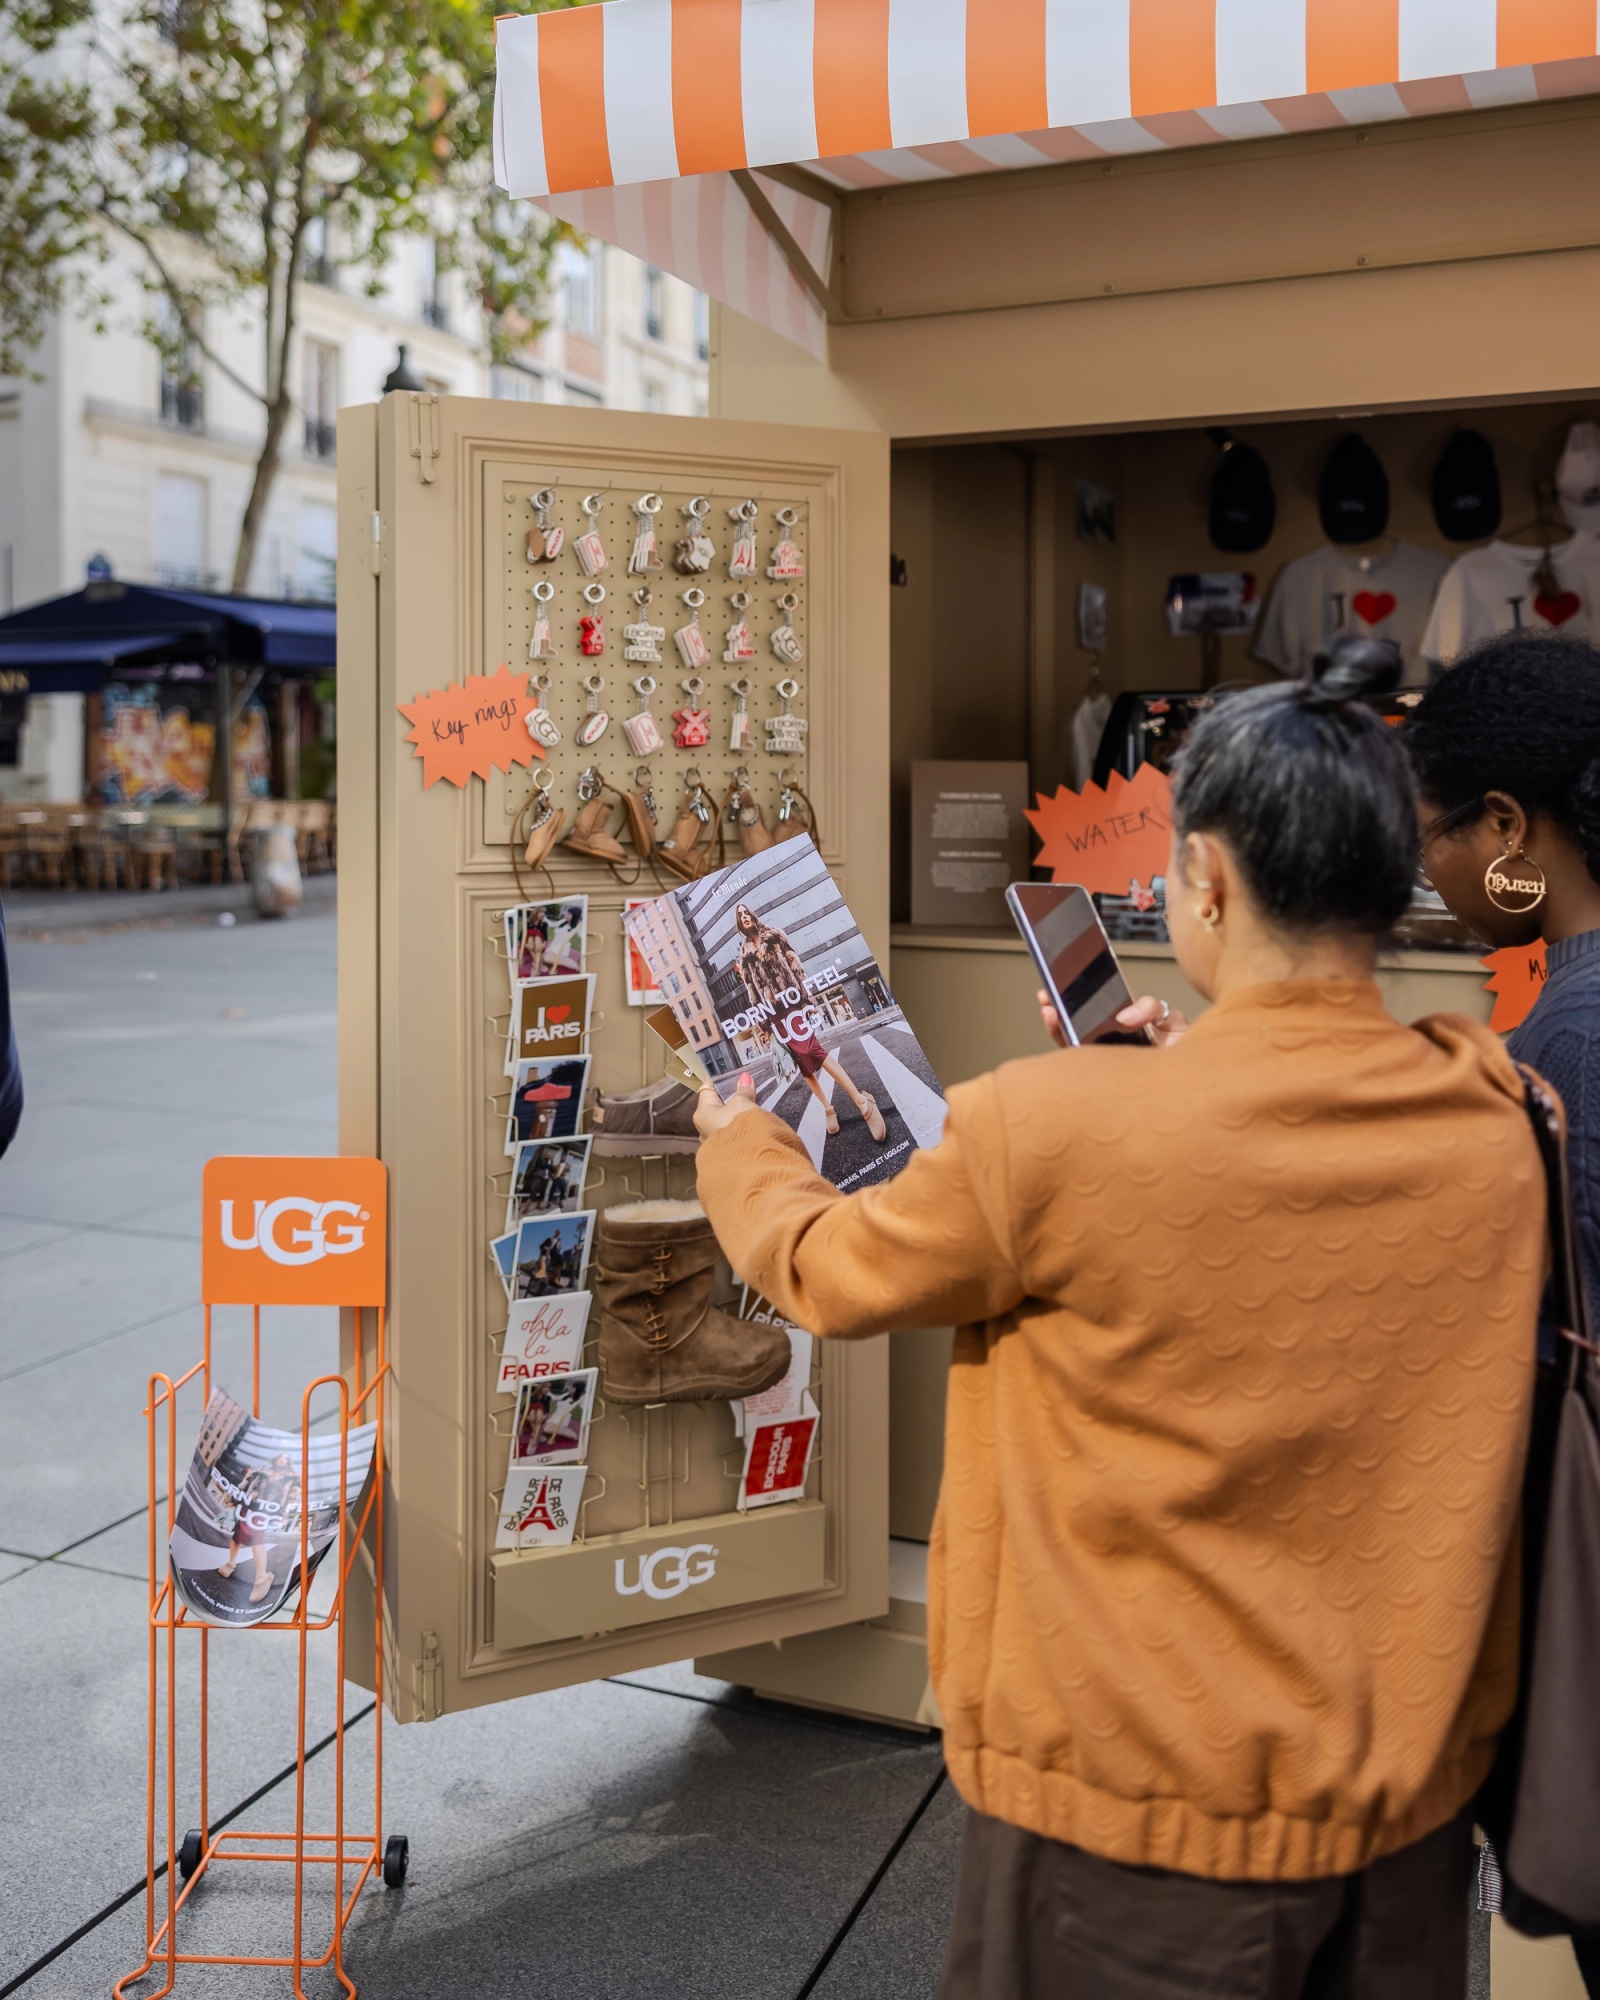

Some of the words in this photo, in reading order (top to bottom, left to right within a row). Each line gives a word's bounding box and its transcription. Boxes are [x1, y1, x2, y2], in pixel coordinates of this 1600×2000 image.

[431, 718, 469, 745] Key
[475, 697, 517, 732] rings
[1065, 806, 1167, 852] WATER
[711, 887, 722, 899] Le
[720, 877, 749, 896] Monde
[1486, 872, 1546, 894] Queen
[537, 1006, 546, 1028] I
[720, 998, 777, 1039] BORN
[775, 986, 801, 1009] TO
[770, 1004, 824, 1045] UGG
[524, 1021, 582, 1045] PARIS
[858, 1160, 877, 1178] PARIS
[875, 1154, 885, 1166] ET
[883, 1140, 911, 1161] UGG.COM
[219, 1195, 366, 1267] UGG
[503, 1361, 571, 1380] PARIS
[210, 1465, 253, 1507] BORN
[256, 1498, 281, 1513] TO
[549, 1478, 563, 1494] DE
[235, 1504, 285, 1531] UGG
[549, 1496, 569, 1528] PARIS
[614, 1543, 717, 1601] UGG
